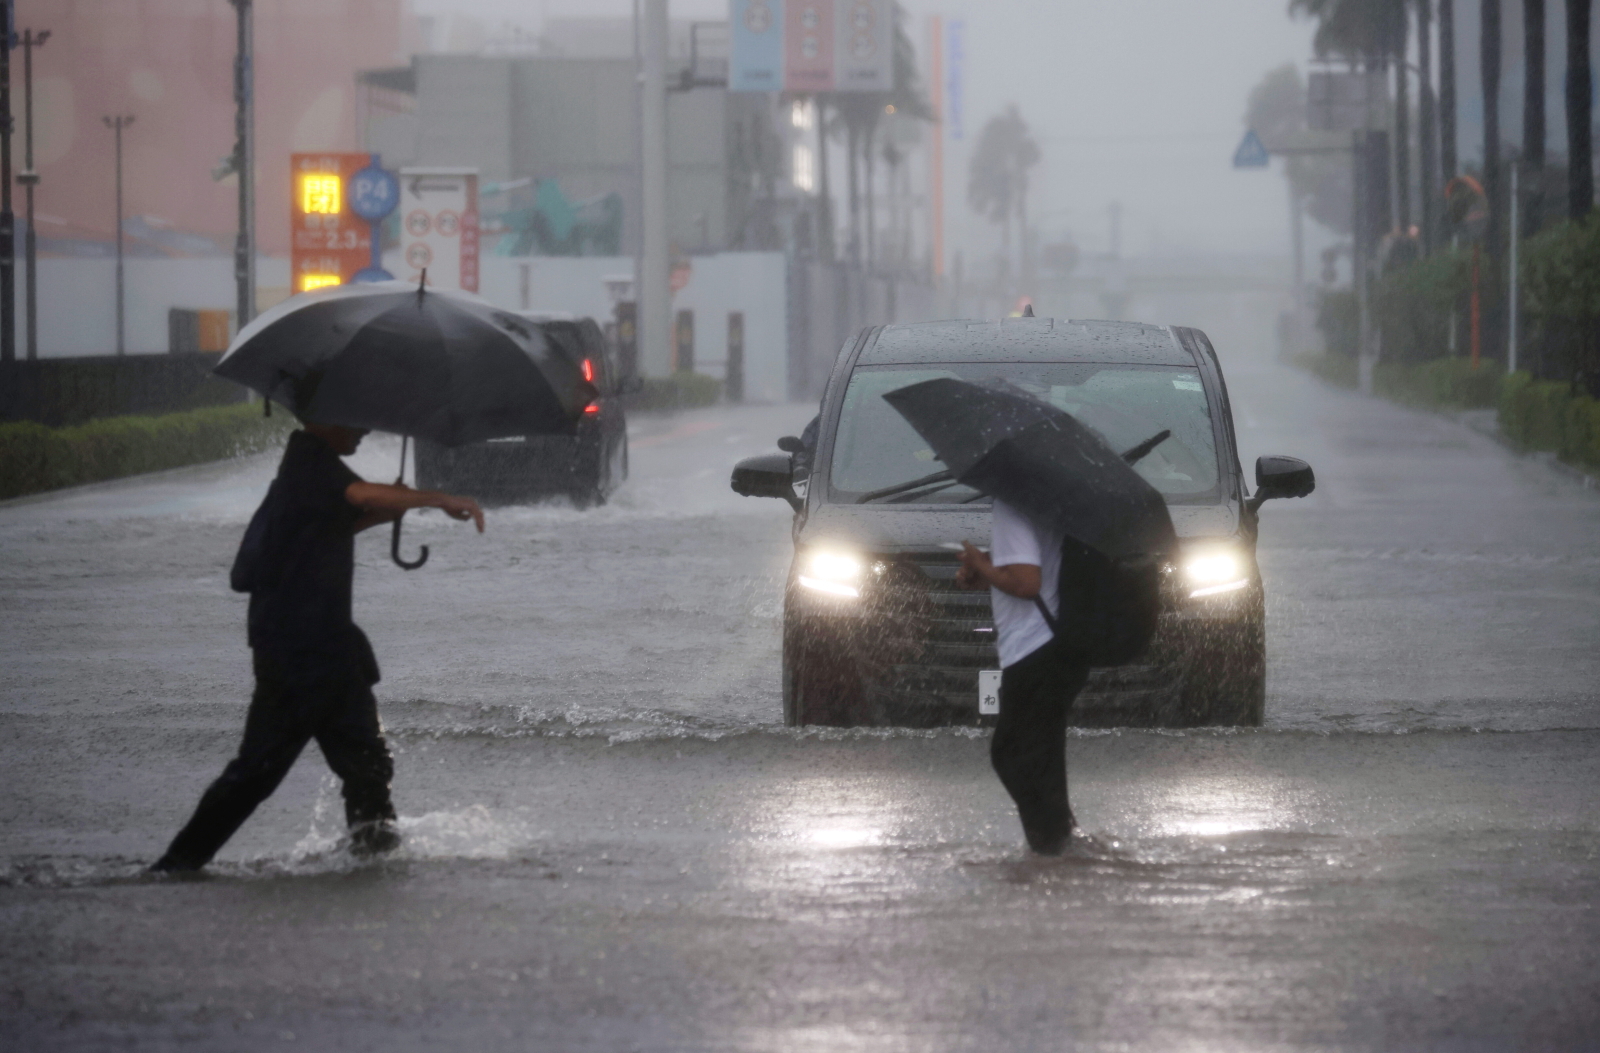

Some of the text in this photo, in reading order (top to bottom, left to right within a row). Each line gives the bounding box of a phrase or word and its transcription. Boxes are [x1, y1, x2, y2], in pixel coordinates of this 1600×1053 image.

[304, 175, 341, 214] 閉
[356, 179, 388, 202] P4
[984, 694, 996, 705] ね
